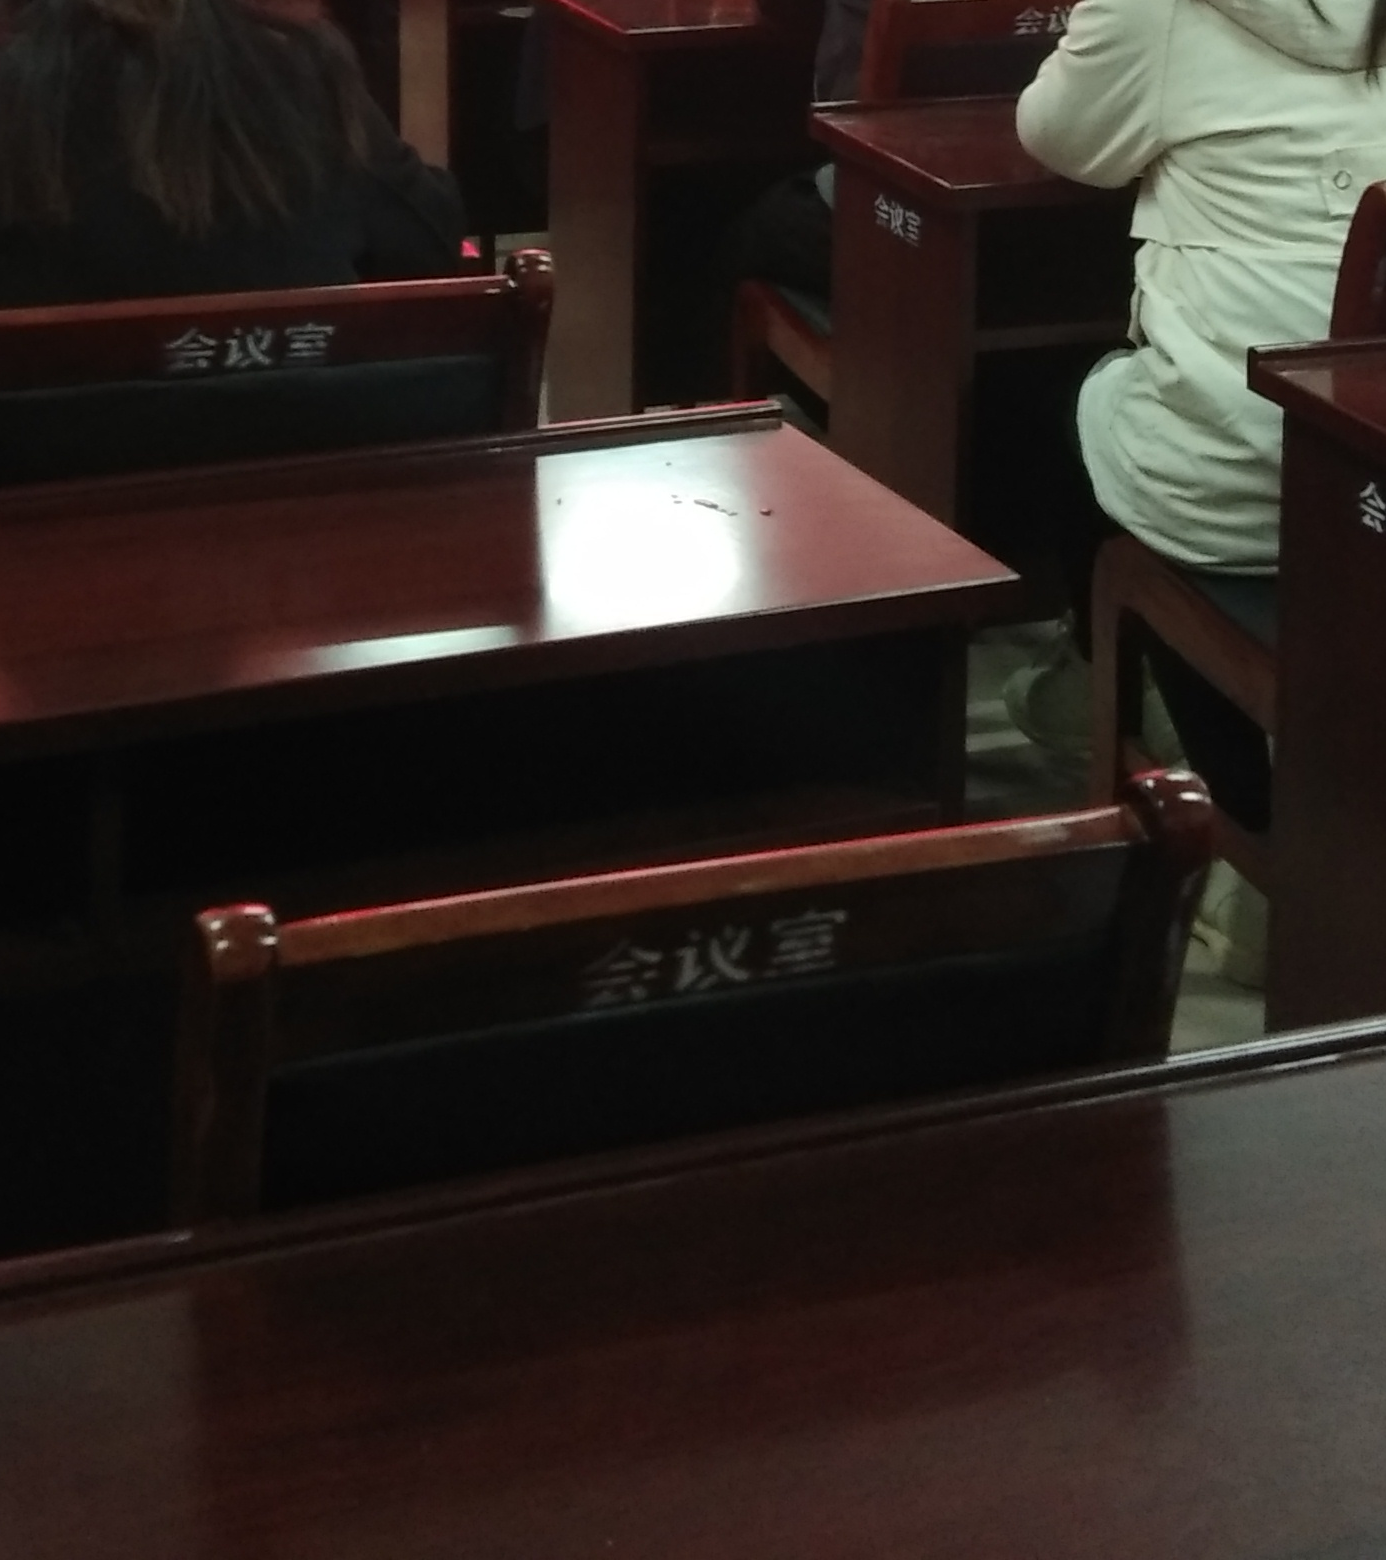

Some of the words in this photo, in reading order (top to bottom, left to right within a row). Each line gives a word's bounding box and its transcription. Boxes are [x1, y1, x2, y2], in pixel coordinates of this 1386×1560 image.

[874, 193, 921, 248] 会议室
[165, 322, 336, 370] 会议室
[581, 908, 850, 1008] 会议室
